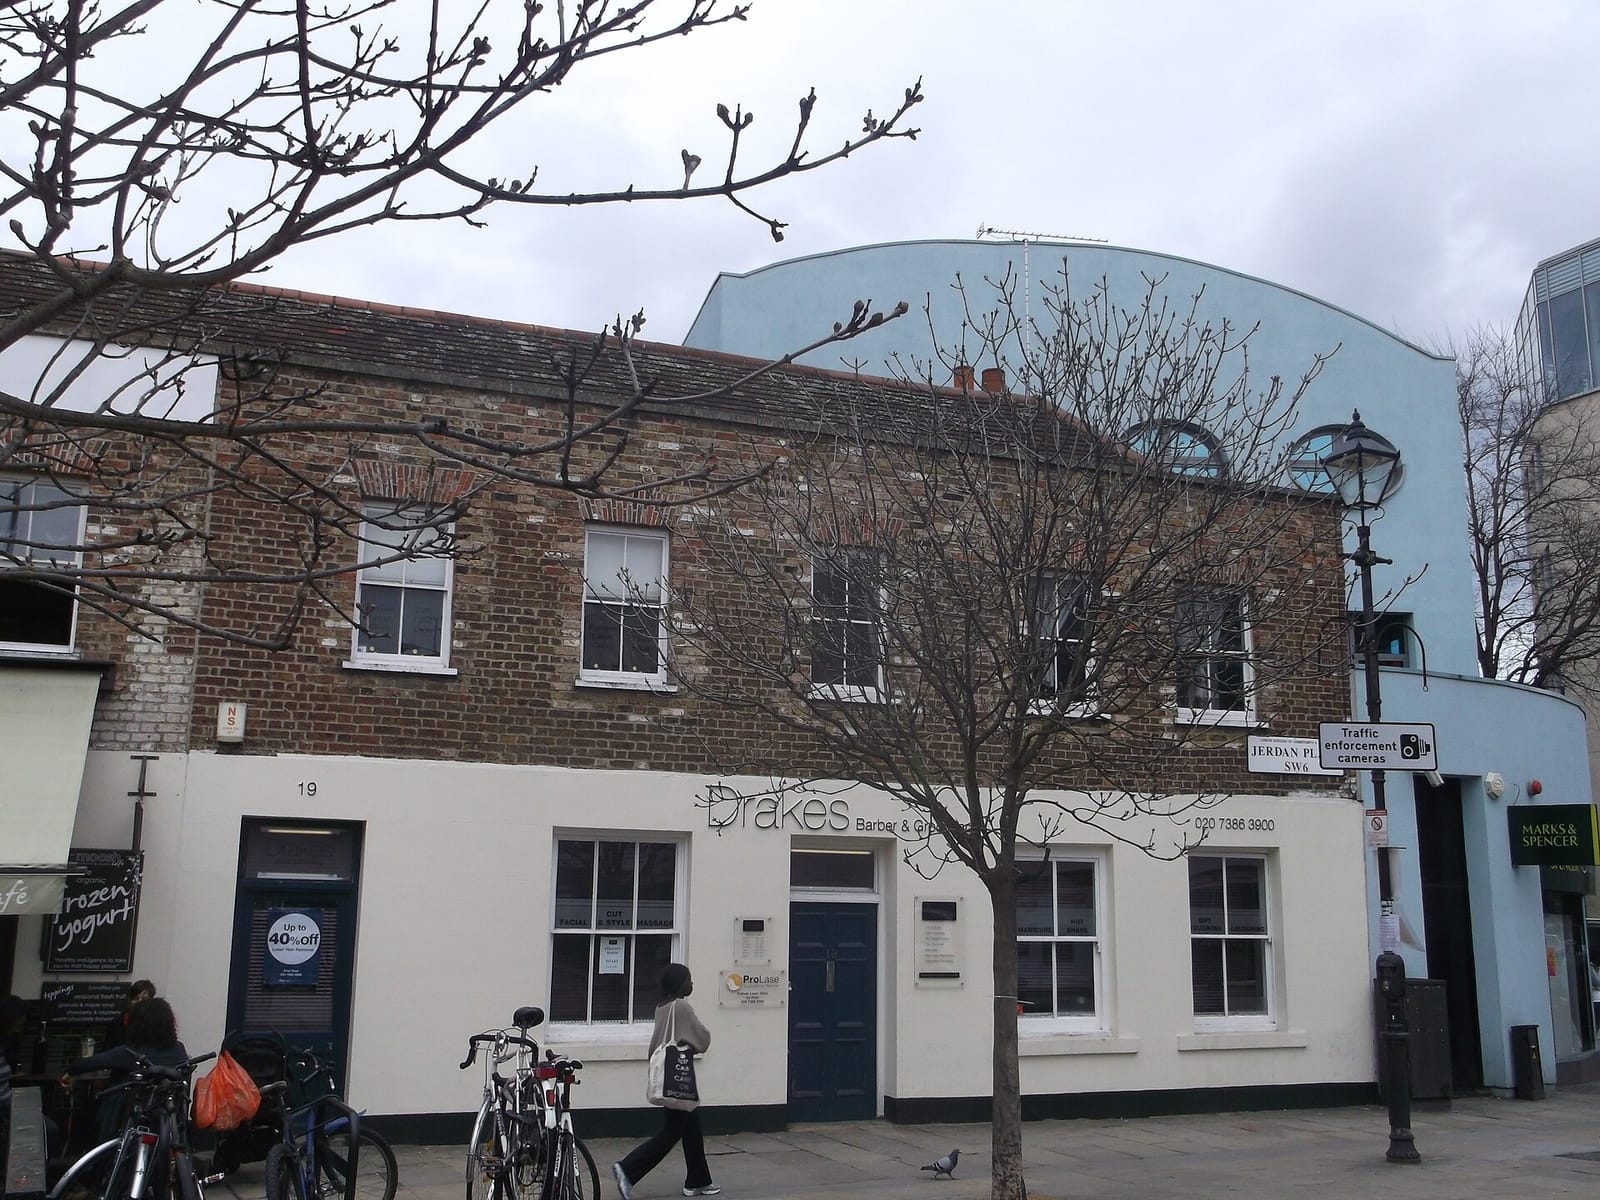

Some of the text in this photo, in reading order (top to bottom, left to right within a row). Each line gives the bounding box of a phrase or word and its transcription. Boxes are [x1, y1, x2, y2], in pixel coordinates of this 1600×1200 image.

[228, 707, 236, 716] N
[227, 717, 236, 726] S
[1341, 728, 1379, 738] Traffic
[1324, 740, 1397, 751] enforcement
[1251, 745, 1320, 759] JERDAN PL
[1337, 753, 1386, 764] cameras
[1284, 761, 1309, 773] SW6
[298, 782, 317, 796] 19
[708, 785, 850, 831] Drakes
[856, 817, 897, 832] Barber
[901, 819, 911, 832] &
[1194, 817, 1275, 831] 020 7386 3900
[1522, 823, 1577, 835] MARKS &
[1522, 835, 1579, 847] SPENCER
[57, 898, 135, 951] yogurt
[283, 924, 307, 932] Up to
[606, 919, 630, 927] STYLE
[743, 975, 779, 984] ProLase
